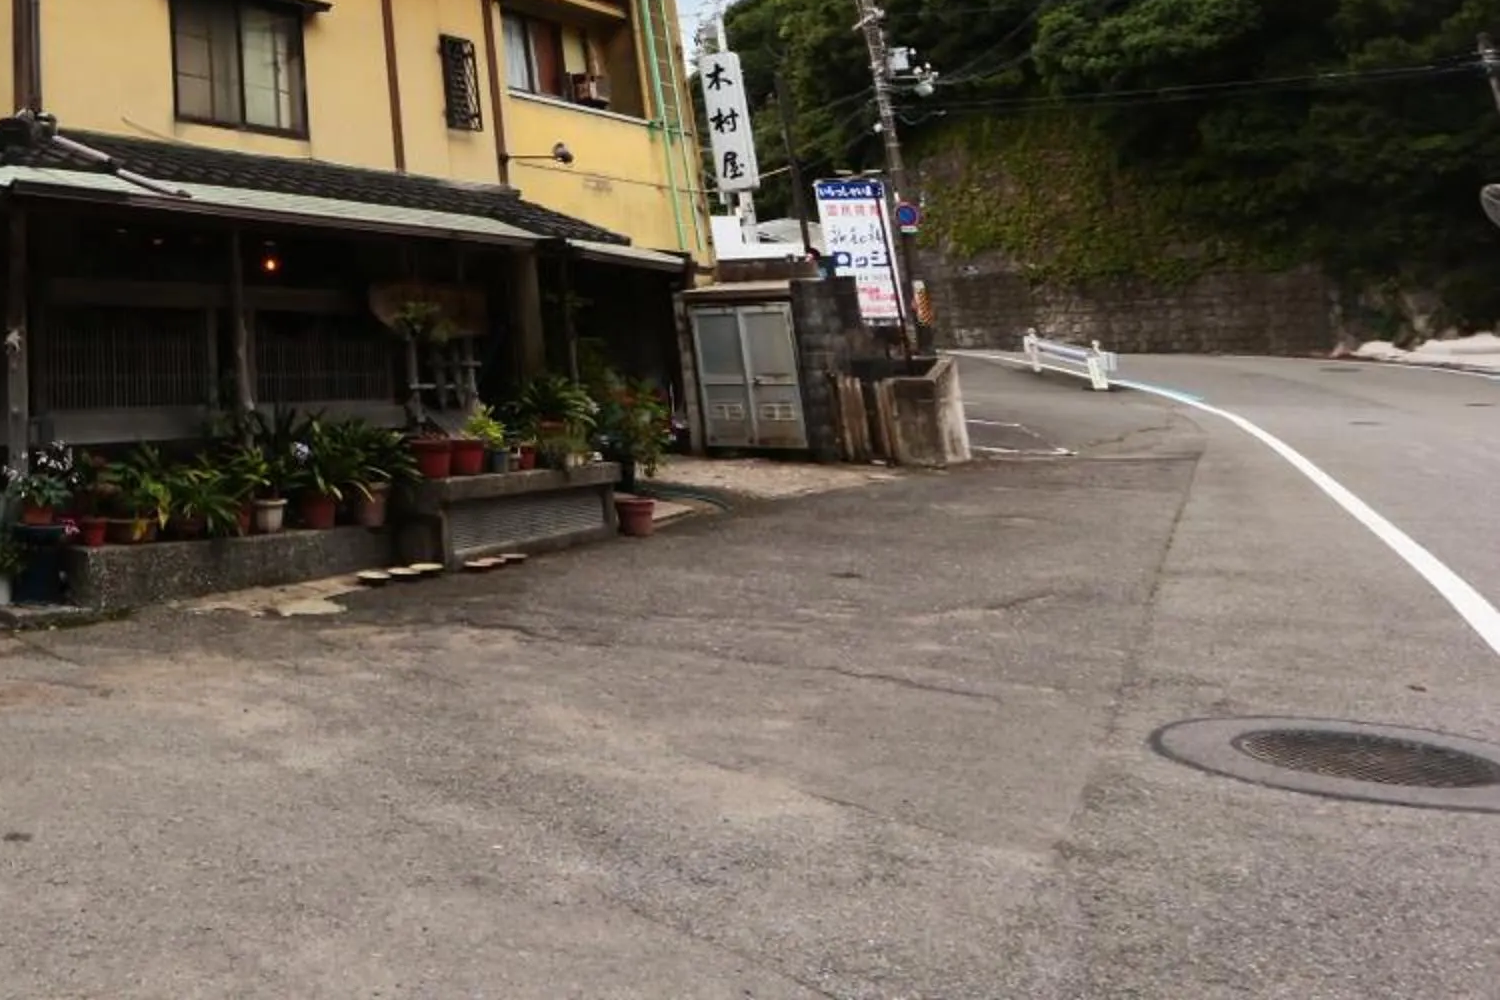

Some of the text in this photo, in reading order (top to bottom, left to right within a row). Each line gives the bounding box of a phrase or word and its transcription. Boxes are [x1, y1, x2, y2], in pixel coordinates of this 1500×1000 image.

[706, 63, 744, 180] 木村屋
[819, 185, 882, 197] いらっしゃいま
